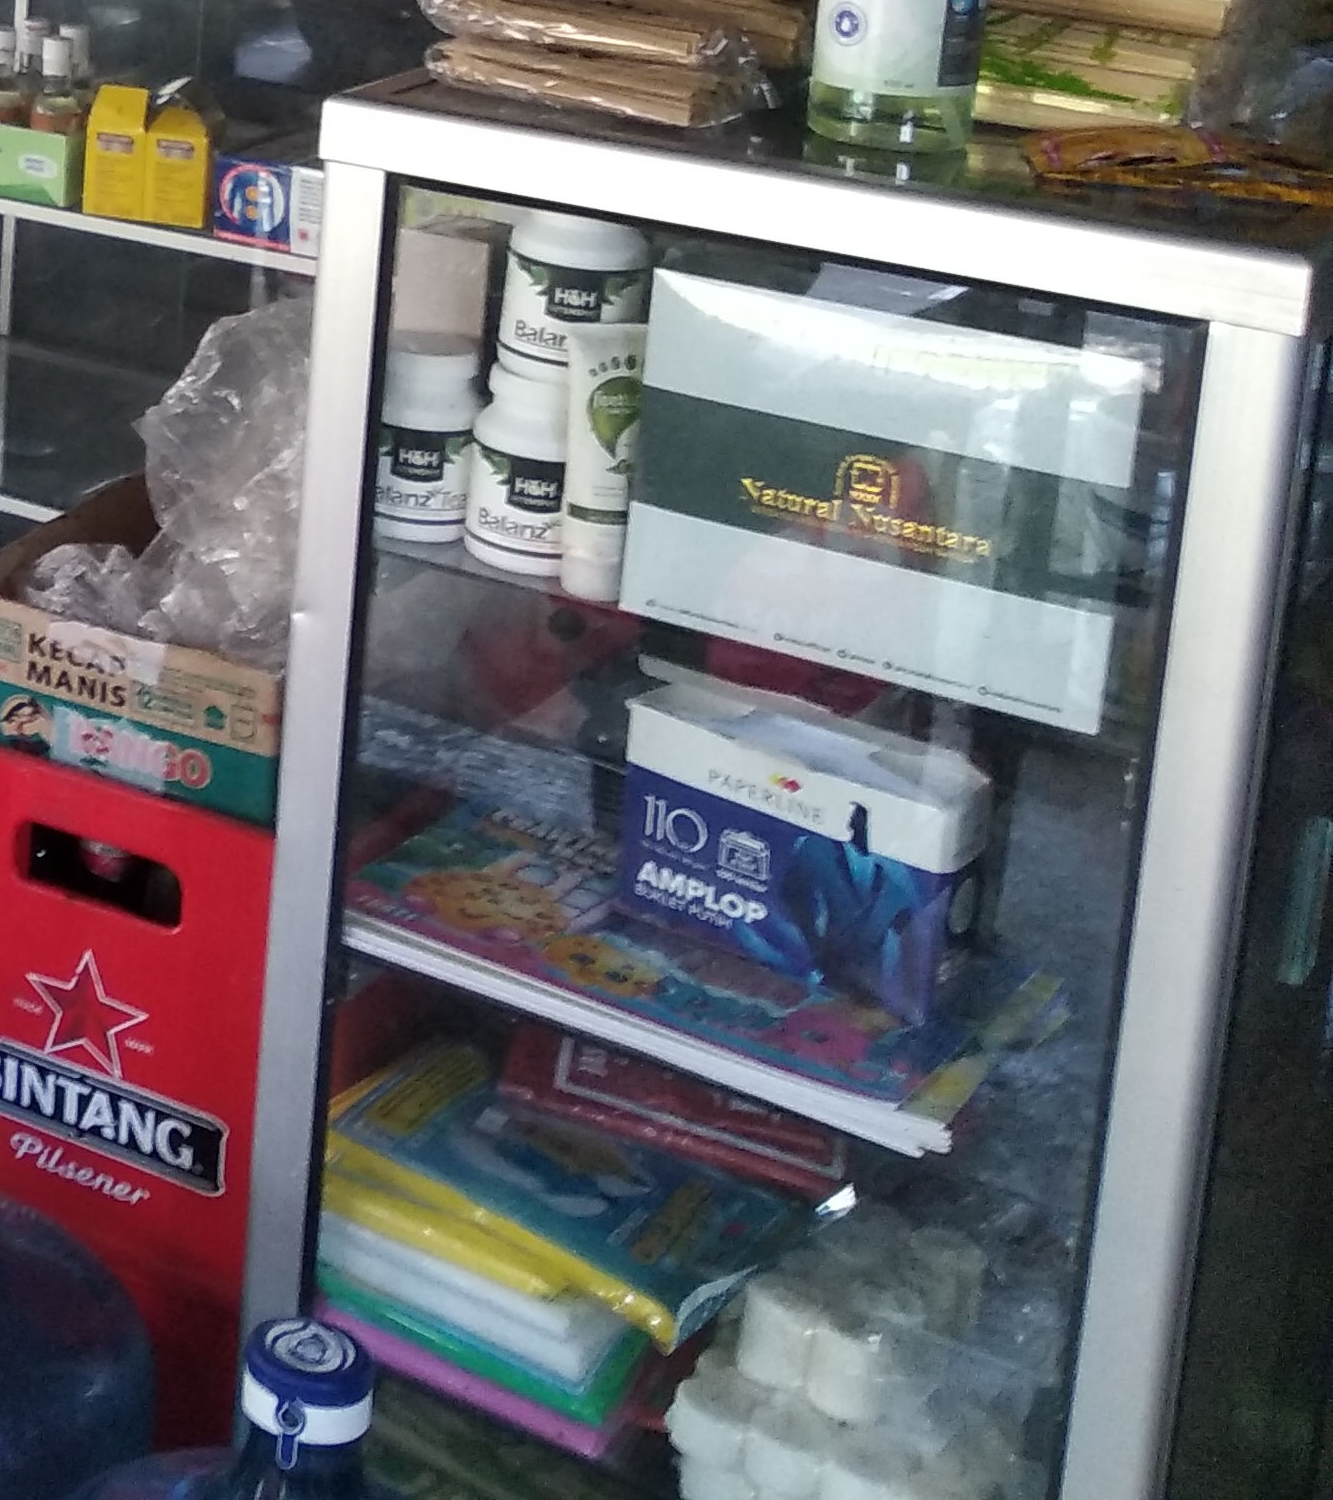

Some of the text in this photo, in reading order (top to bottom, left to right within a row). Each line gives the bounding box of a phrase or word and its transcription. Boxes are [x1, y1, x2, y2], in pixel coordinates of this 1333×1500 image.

[375, 485, 431, 508] alanz
[479, 507, 550, 540] Balanz
[739, 477, 990, 556] Natural Nusantara
[27, 661, 126, 708] MANIS
[644, 795, 709, 853] 110
[709, 768, 822, 824] PAPERLINE
[636, 860, 769, 924] AMPLOP
[10, 1132, 151, 1205] Pilsener
